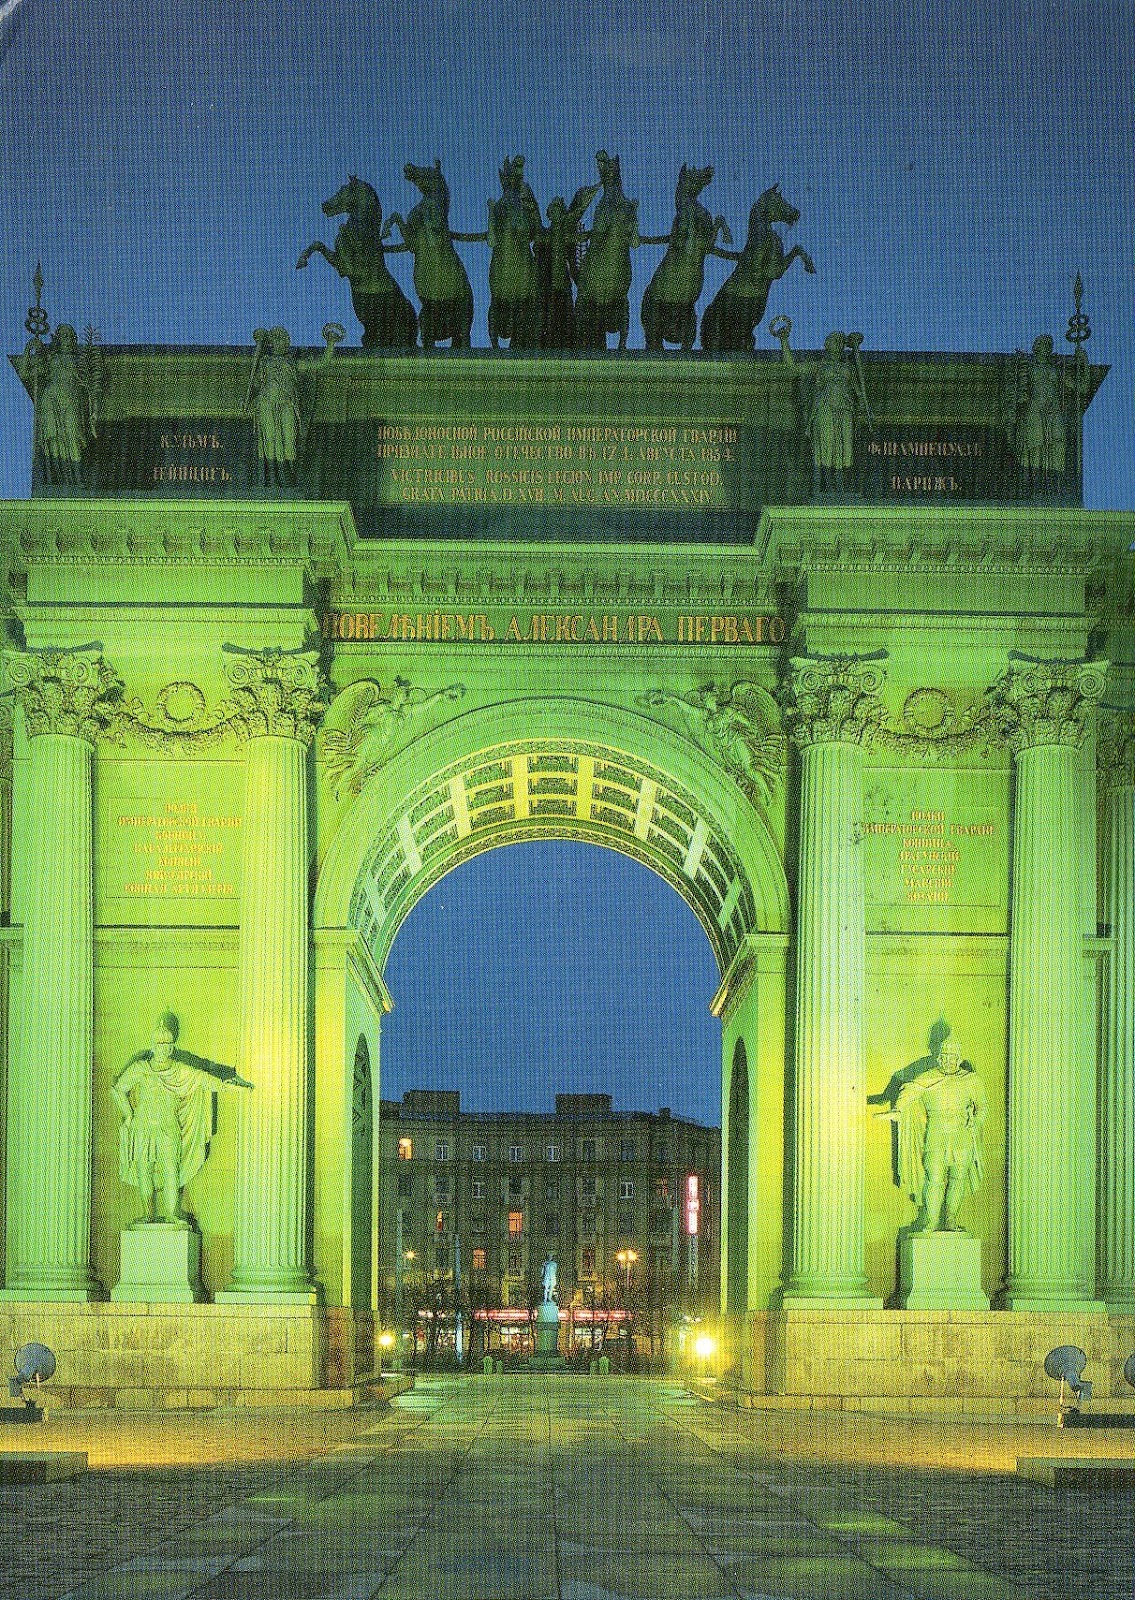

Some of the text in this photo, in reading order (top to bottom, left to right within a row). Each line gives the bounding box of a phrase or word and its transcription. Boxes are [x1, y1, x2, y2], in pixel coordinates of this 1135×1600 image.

[486, 469, 543, 484] ROSSICIS
[504, 614, 664, 641] АЛЕКСАНДРА
[677, 615, 786, 642] ПЕРВАГО
